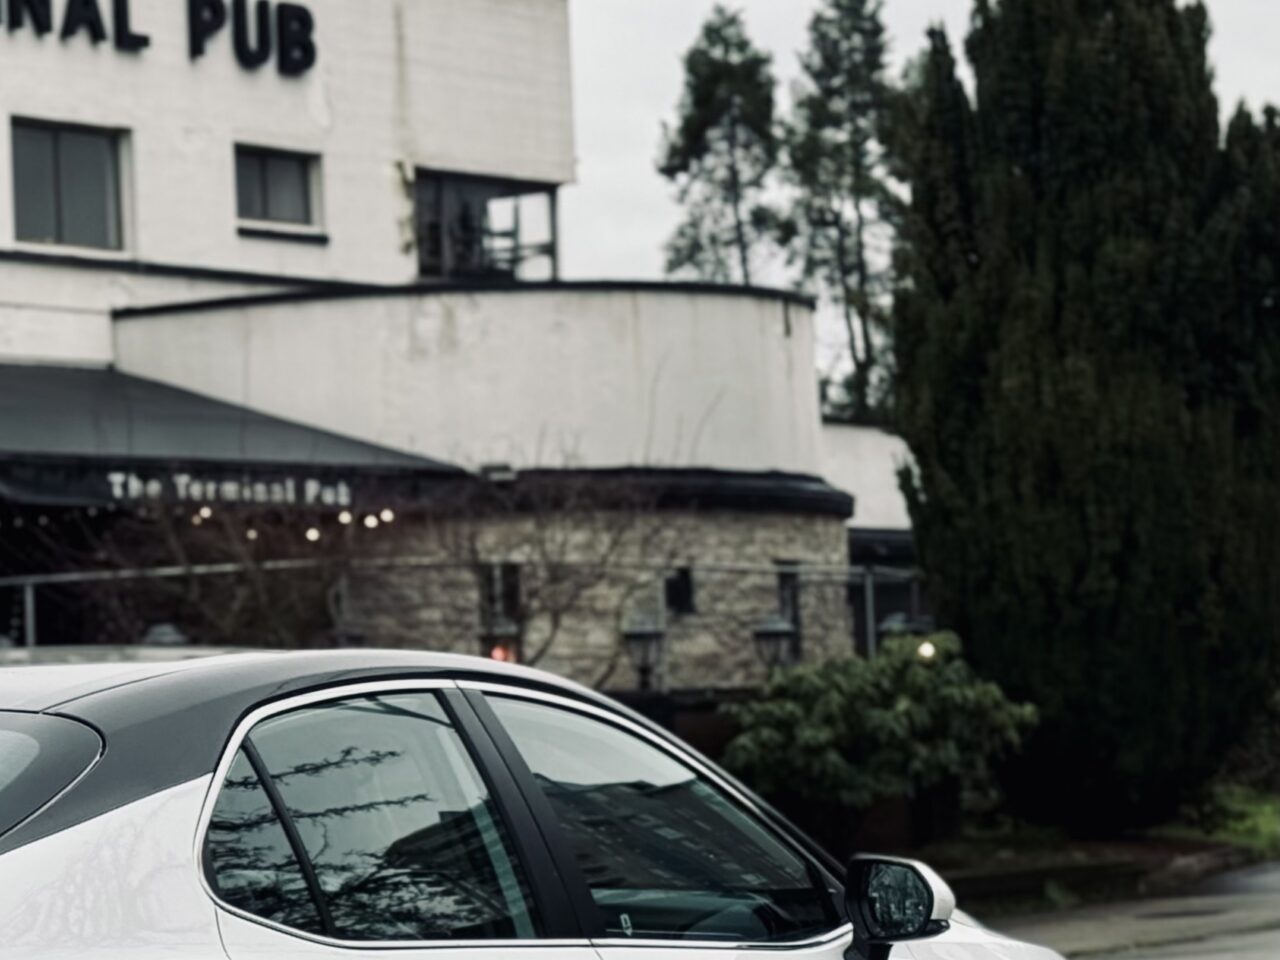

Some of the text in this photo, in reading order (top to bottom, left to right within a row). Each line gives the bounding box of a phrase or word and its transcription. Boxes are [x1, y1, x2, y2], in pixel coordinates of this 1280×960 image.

[187, 0, 317, 78] PUB
[107, 472, 351, 506] The Terminal Pub
